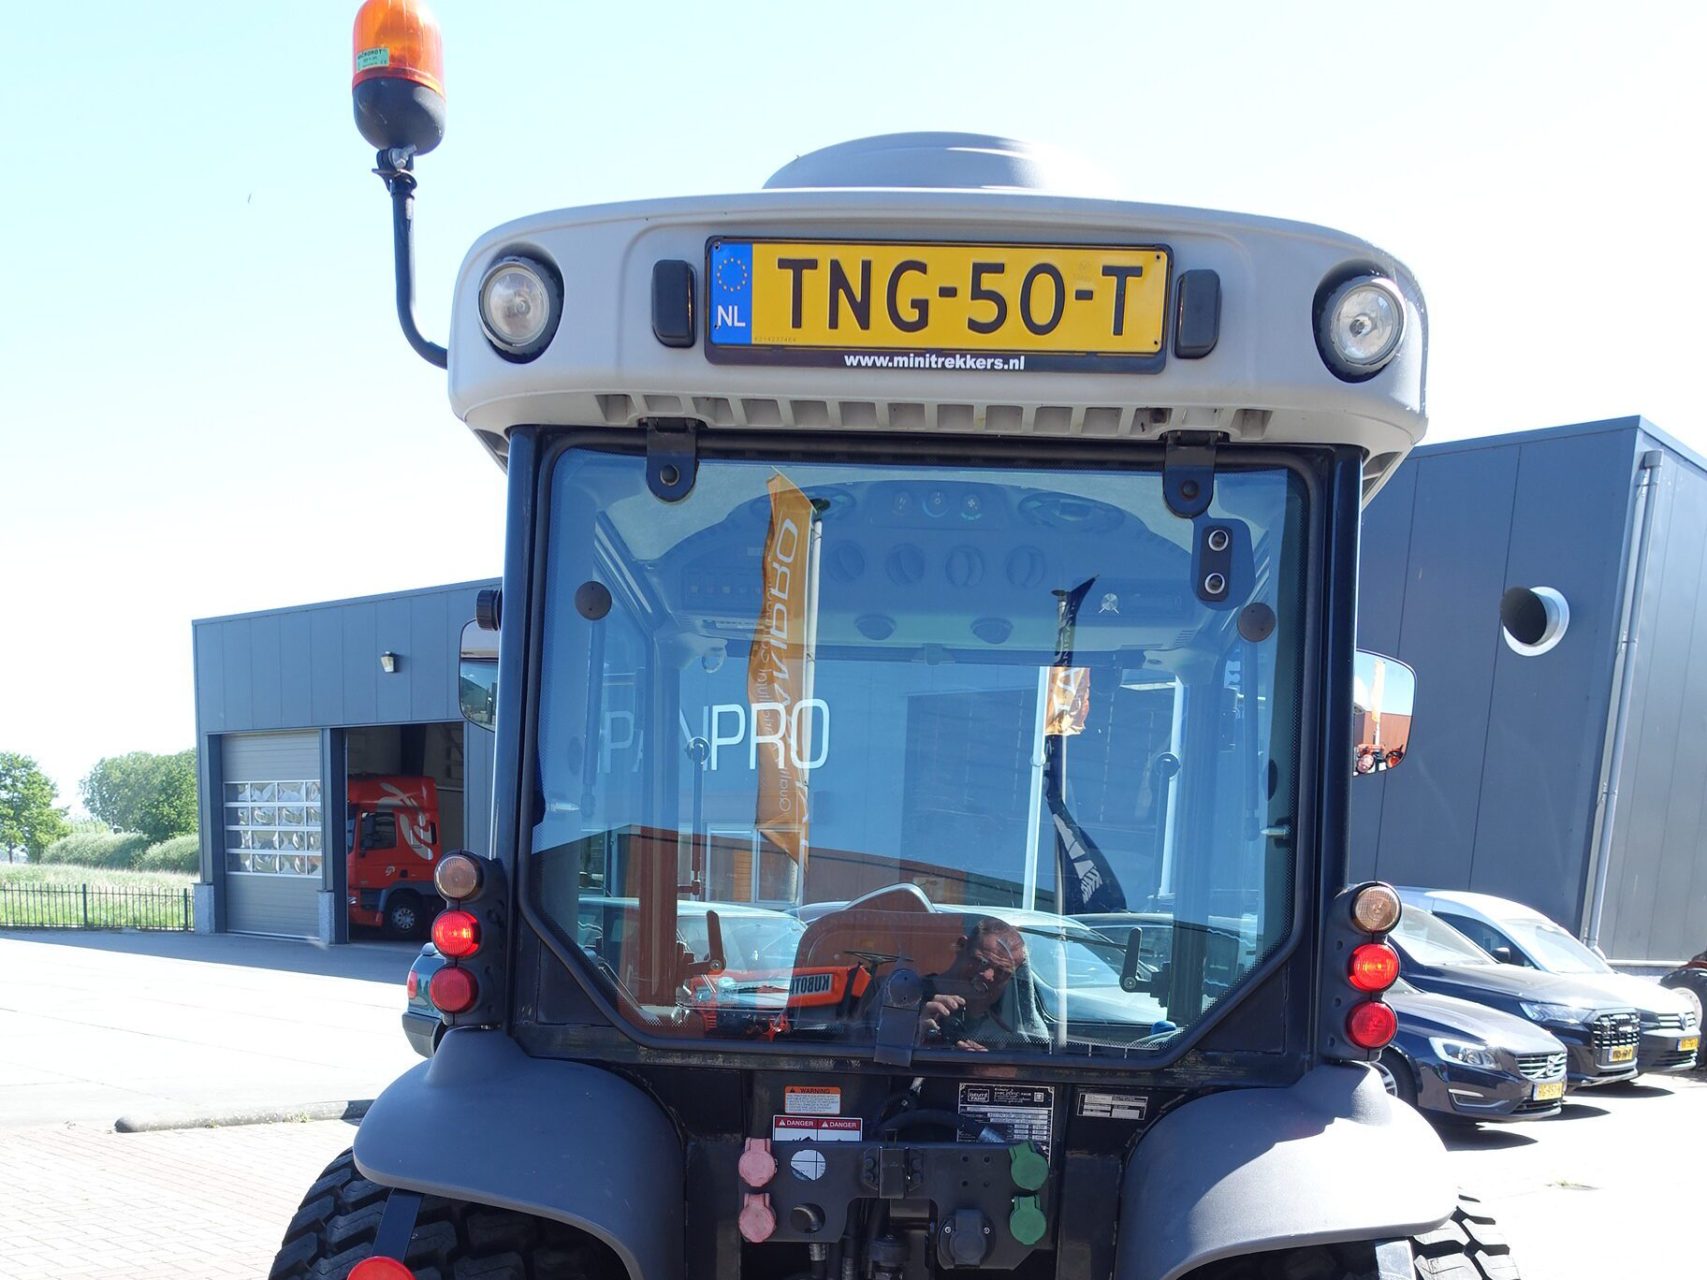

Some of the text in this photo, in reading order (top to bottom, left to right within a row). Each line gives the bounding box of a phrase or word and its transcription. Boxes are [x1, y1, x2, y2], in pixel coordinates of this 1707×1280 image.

[776, 258, 1144, 337] TNG-50-T
[716, 305, 746, 328] NL
[844, 353, 1026, 371] www.minitrekkers.nl
